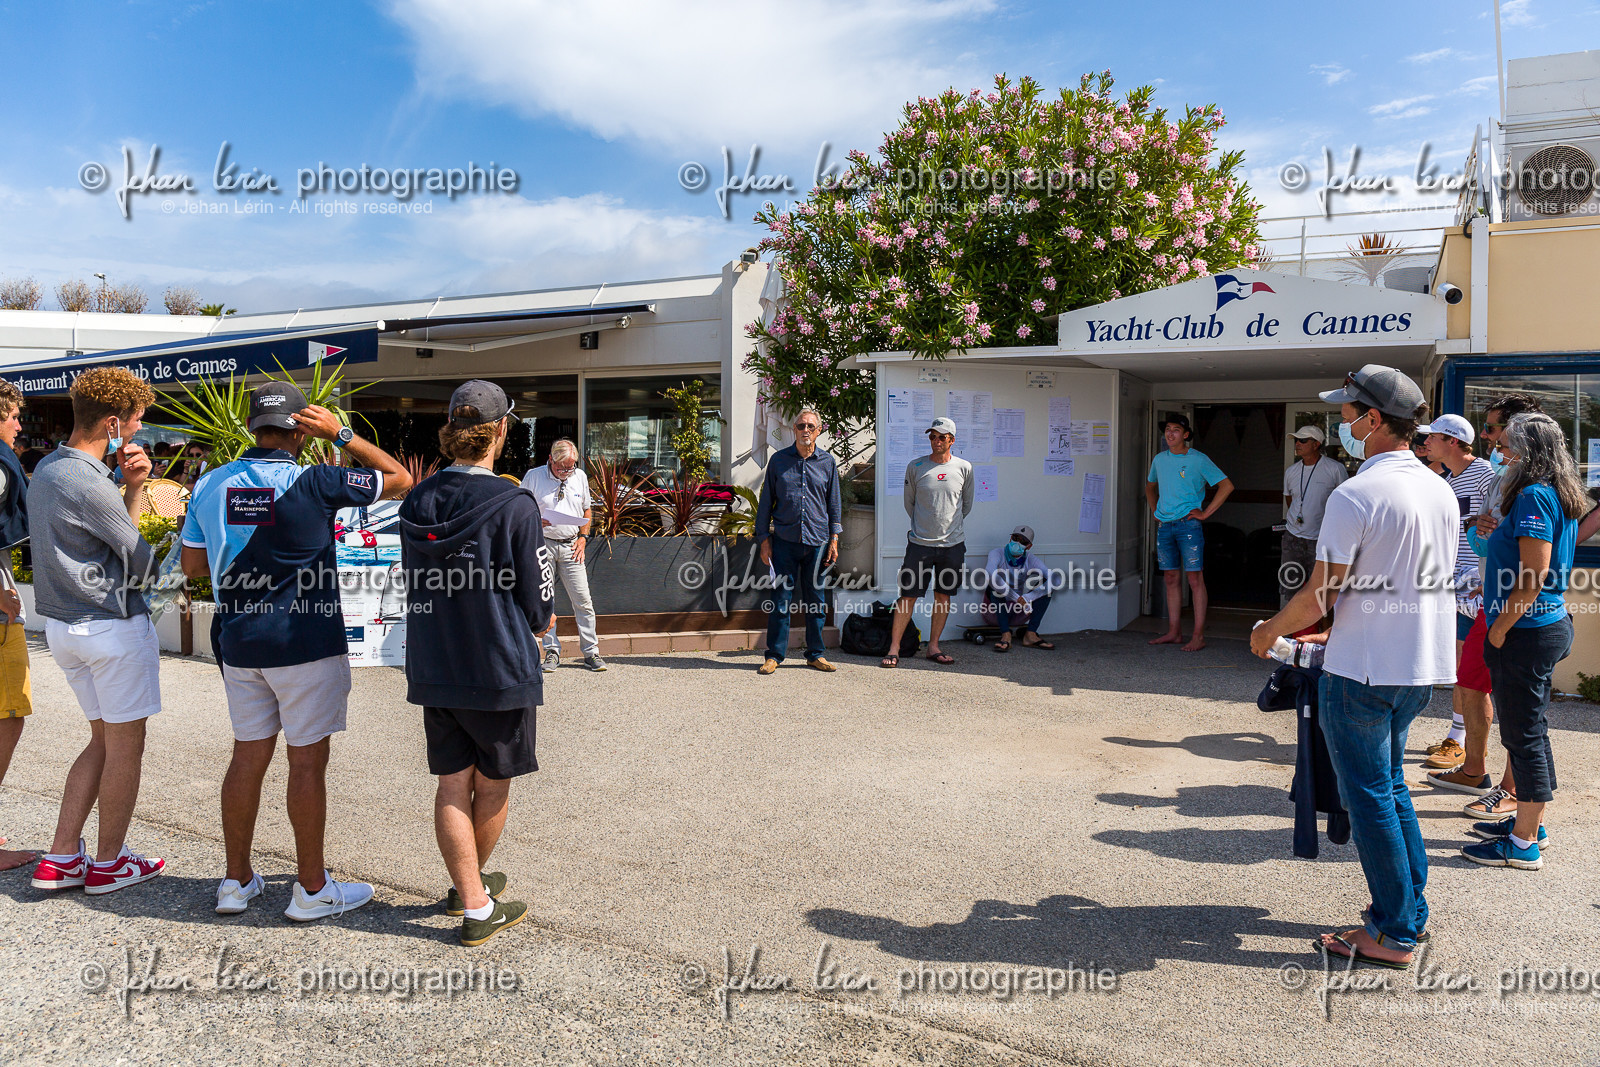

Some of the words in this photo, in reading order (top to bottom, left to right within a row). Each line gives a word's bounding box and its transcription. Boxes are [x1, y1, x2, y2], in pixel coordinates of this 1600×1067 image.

[1085, 312, 1225, 343] Yacht-Club
[1245, 312, 1280, 338] de
[1302, 311, 1412, 336] Cannes
[1, 372, 68, 392] staurant
[153, 360, 173, 379] de
[175, 357, 238, 376] Cannes
[535, 544, 555, 602] slam
